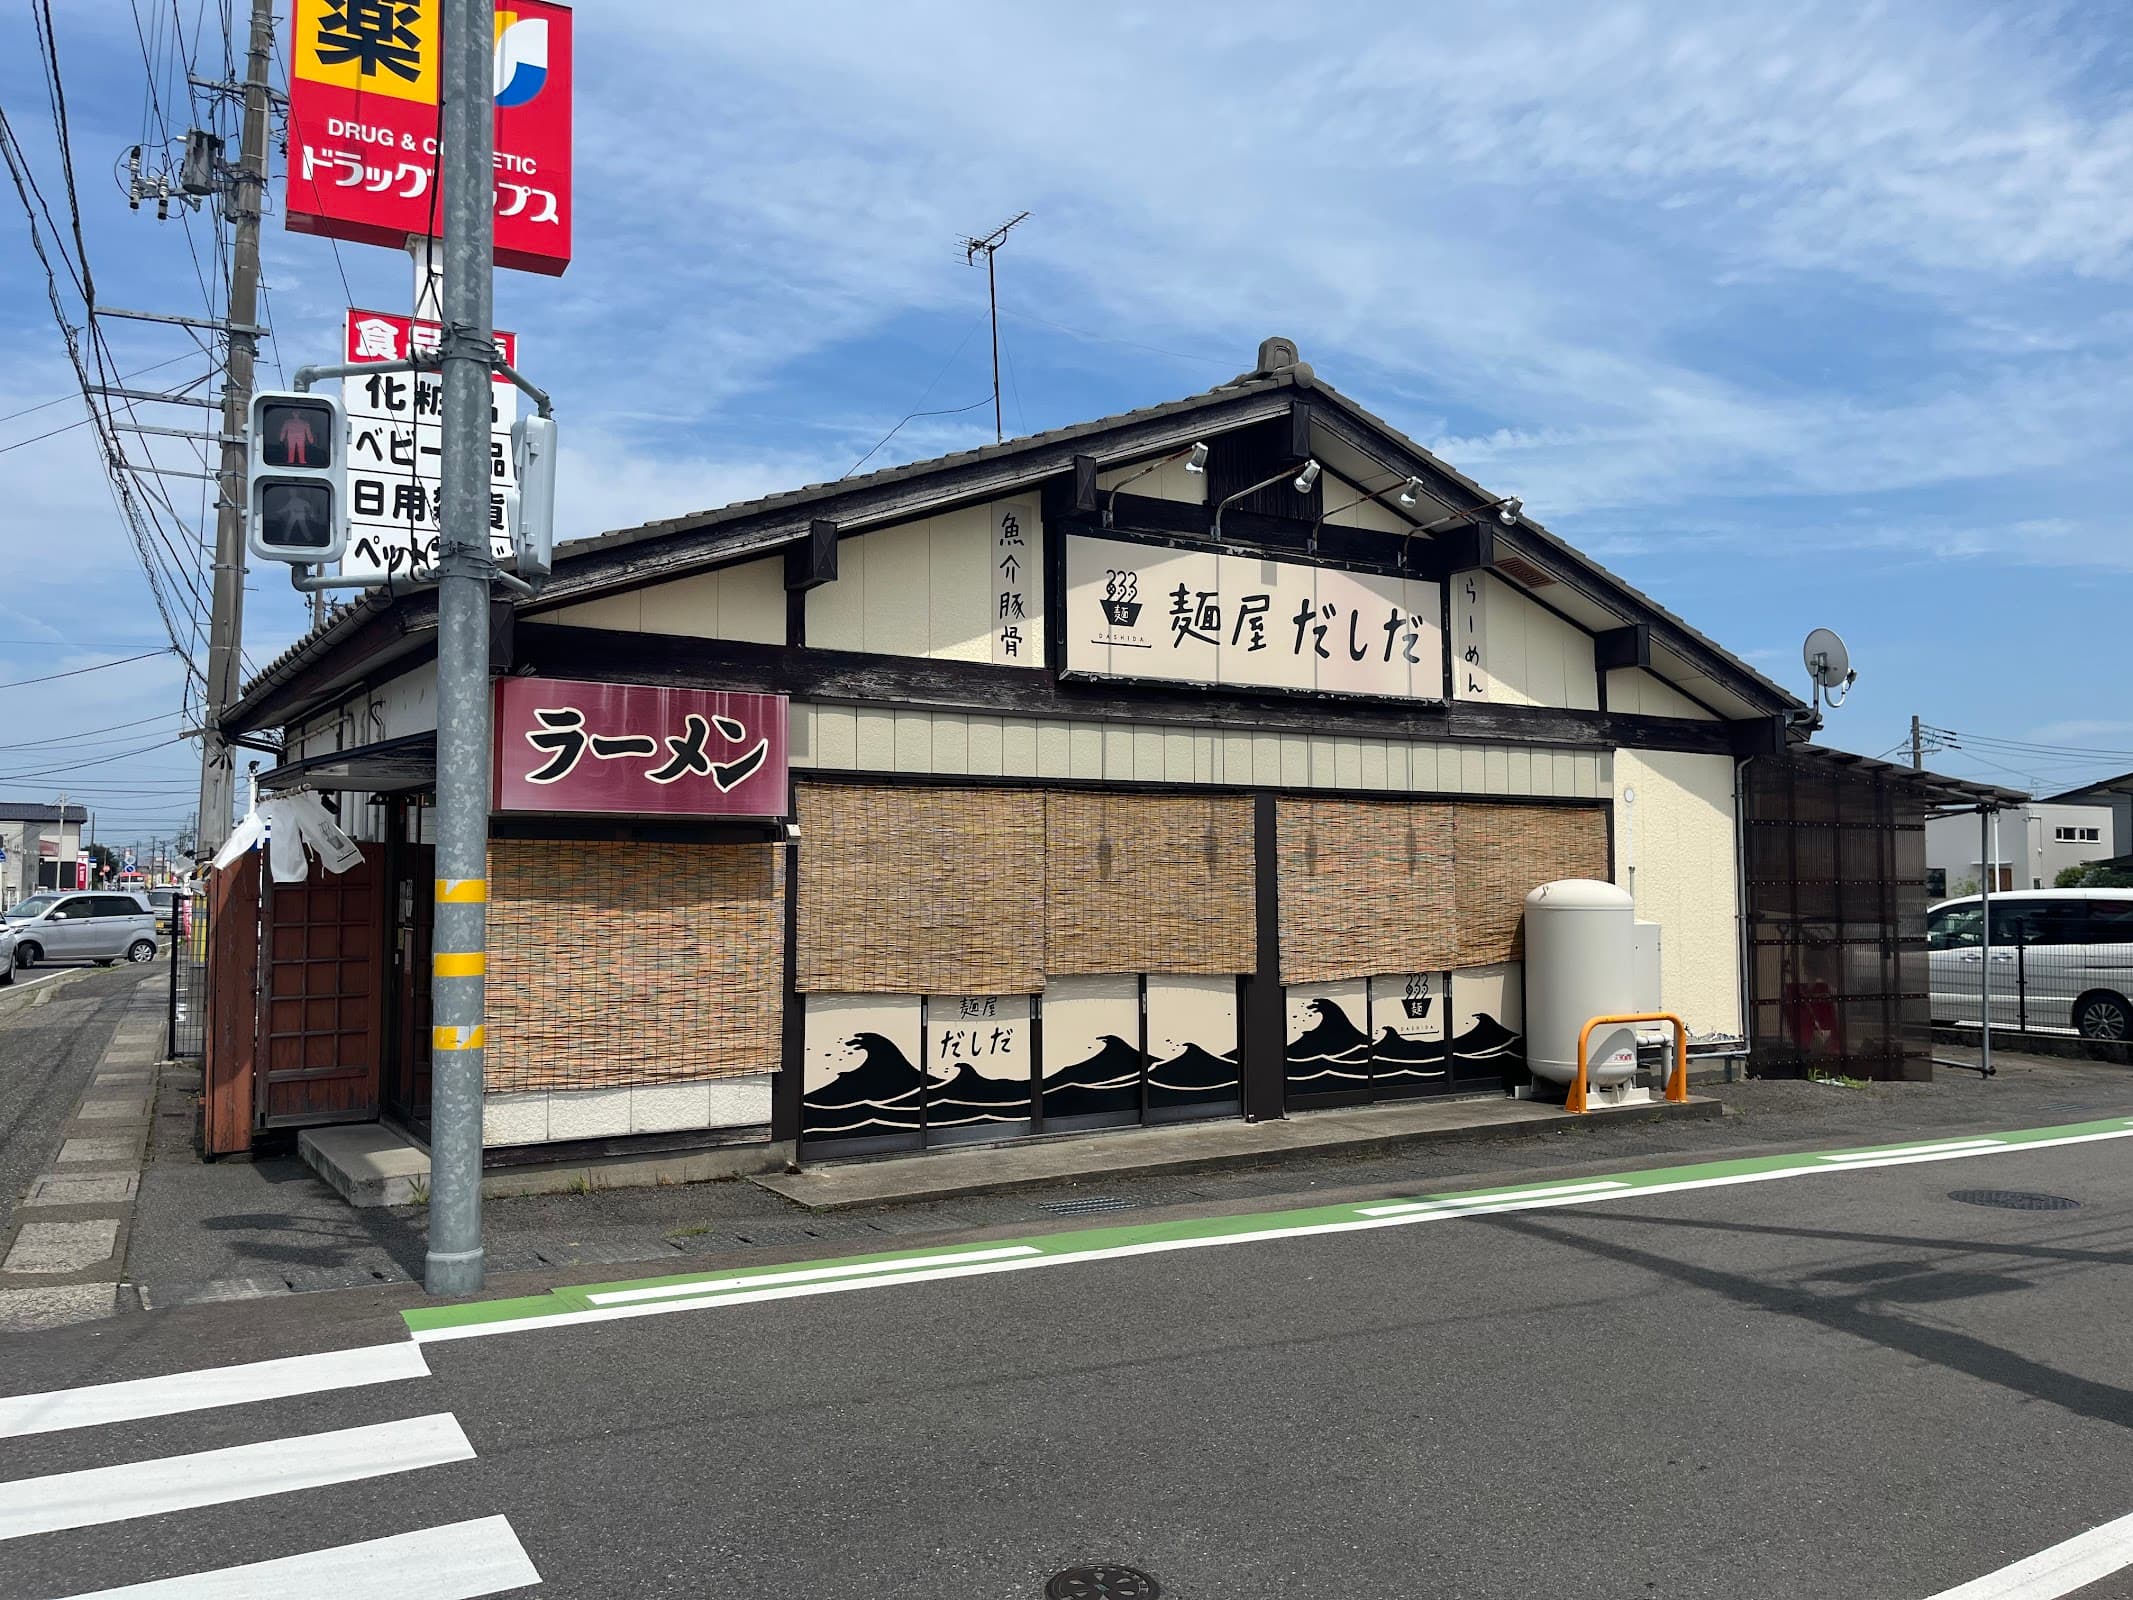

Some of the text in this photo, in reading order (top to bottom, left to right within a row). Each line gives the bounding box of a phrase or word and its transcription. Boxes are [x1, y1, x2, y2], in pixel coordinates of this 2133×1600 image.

[315, 0, 421, 83] 薬
[328, 118, 394, 147] DRUG
[401, 133, 417, 152] &
[1000, 512, 1025, 657] 魚介豚骨
[1113, 604, 1129, 623] 麺
[1098, 633, 1144, 642] DASHIDA
[1465, 577, 1483, 692] らーめん
[526, 707, 768, 793] ラーメン
[960, 996, 998, 1019] 麺屋
[941, 1027, 1013, 1058] だしだ
